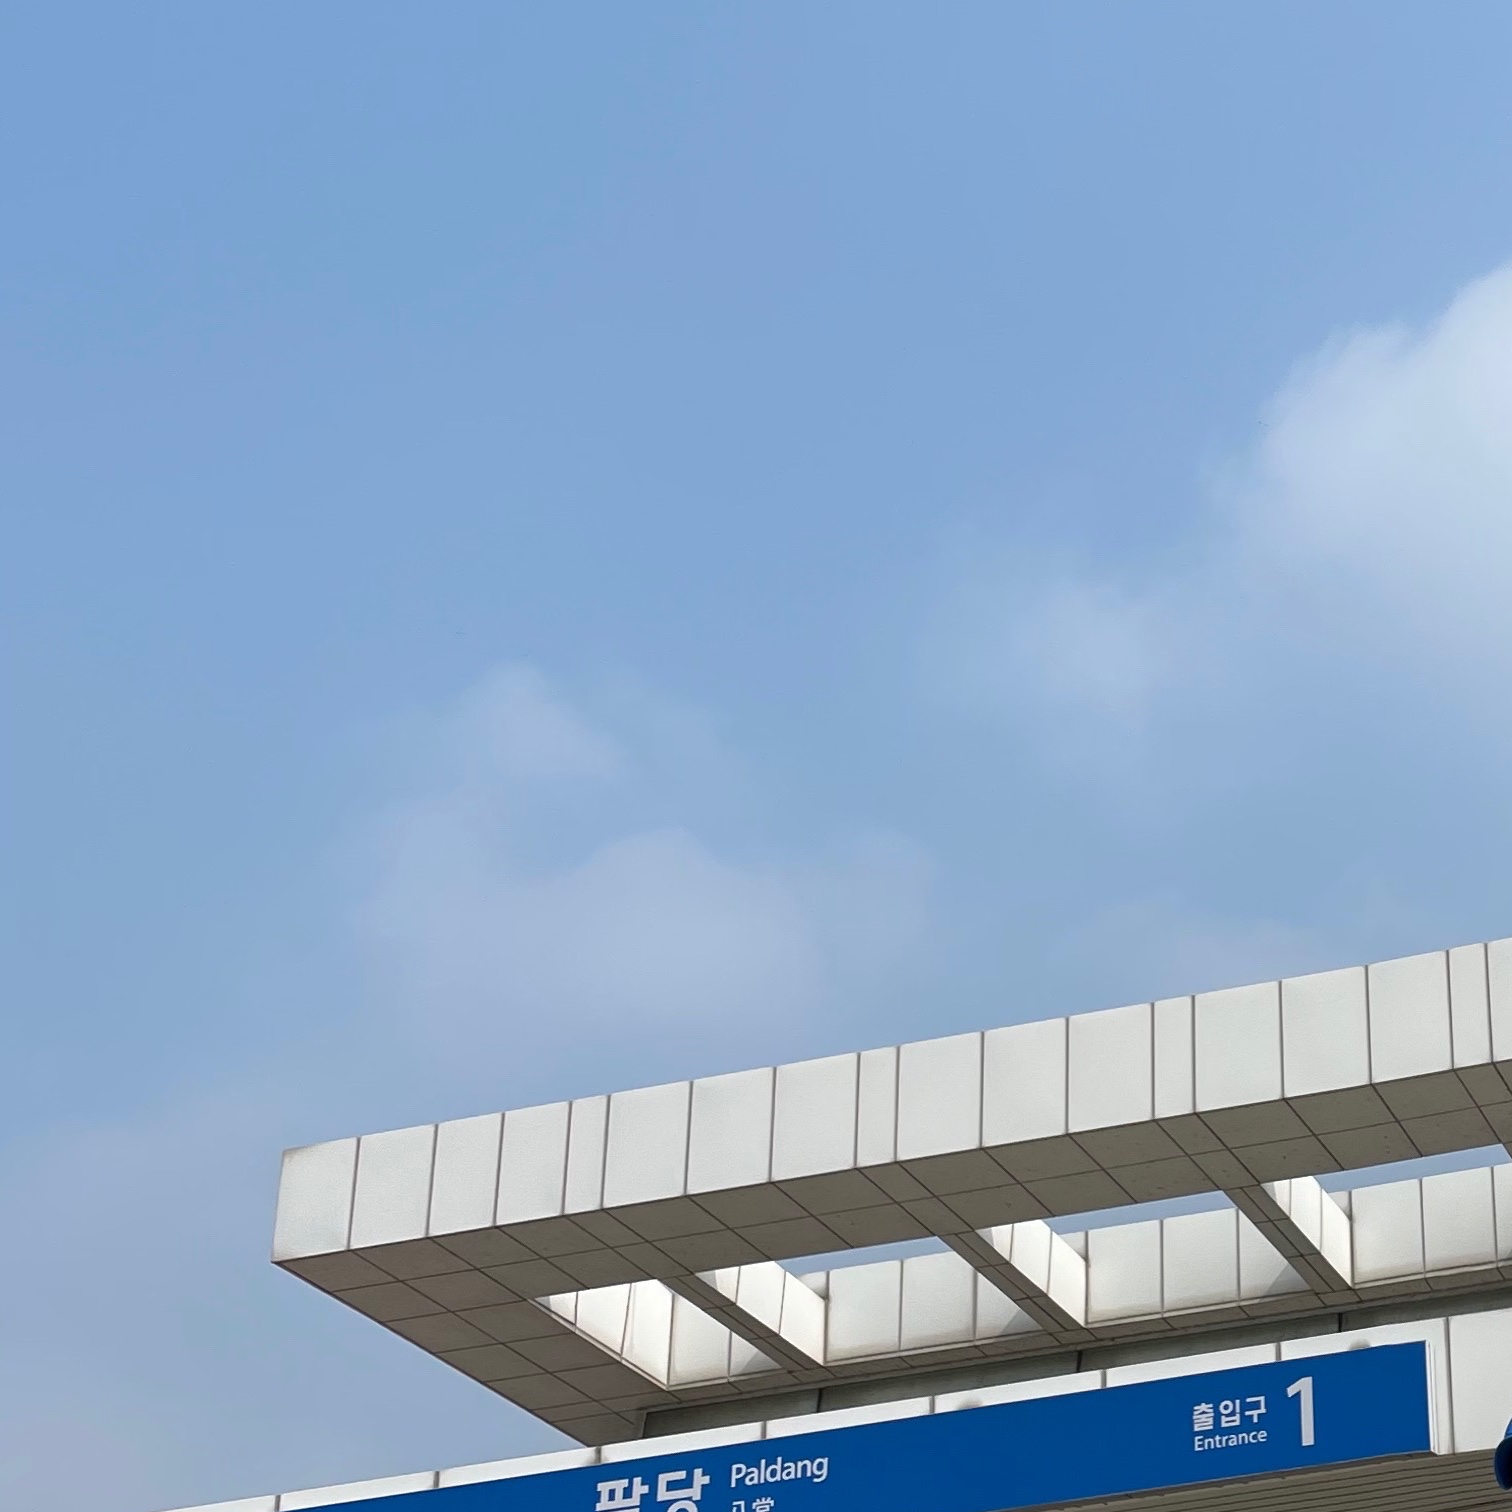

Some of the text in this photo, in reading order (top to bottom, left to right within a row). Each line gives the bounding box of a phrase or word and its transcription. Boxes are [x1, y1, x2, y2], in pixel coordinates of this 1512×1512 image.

[1192, 1395, 1267, 1431] 출입구
[1286, 1376, 1315, 1447] 1
[1193, 1430, 1268, 1451] Entrance
[730, 1456, 829, 1488] Paldang
